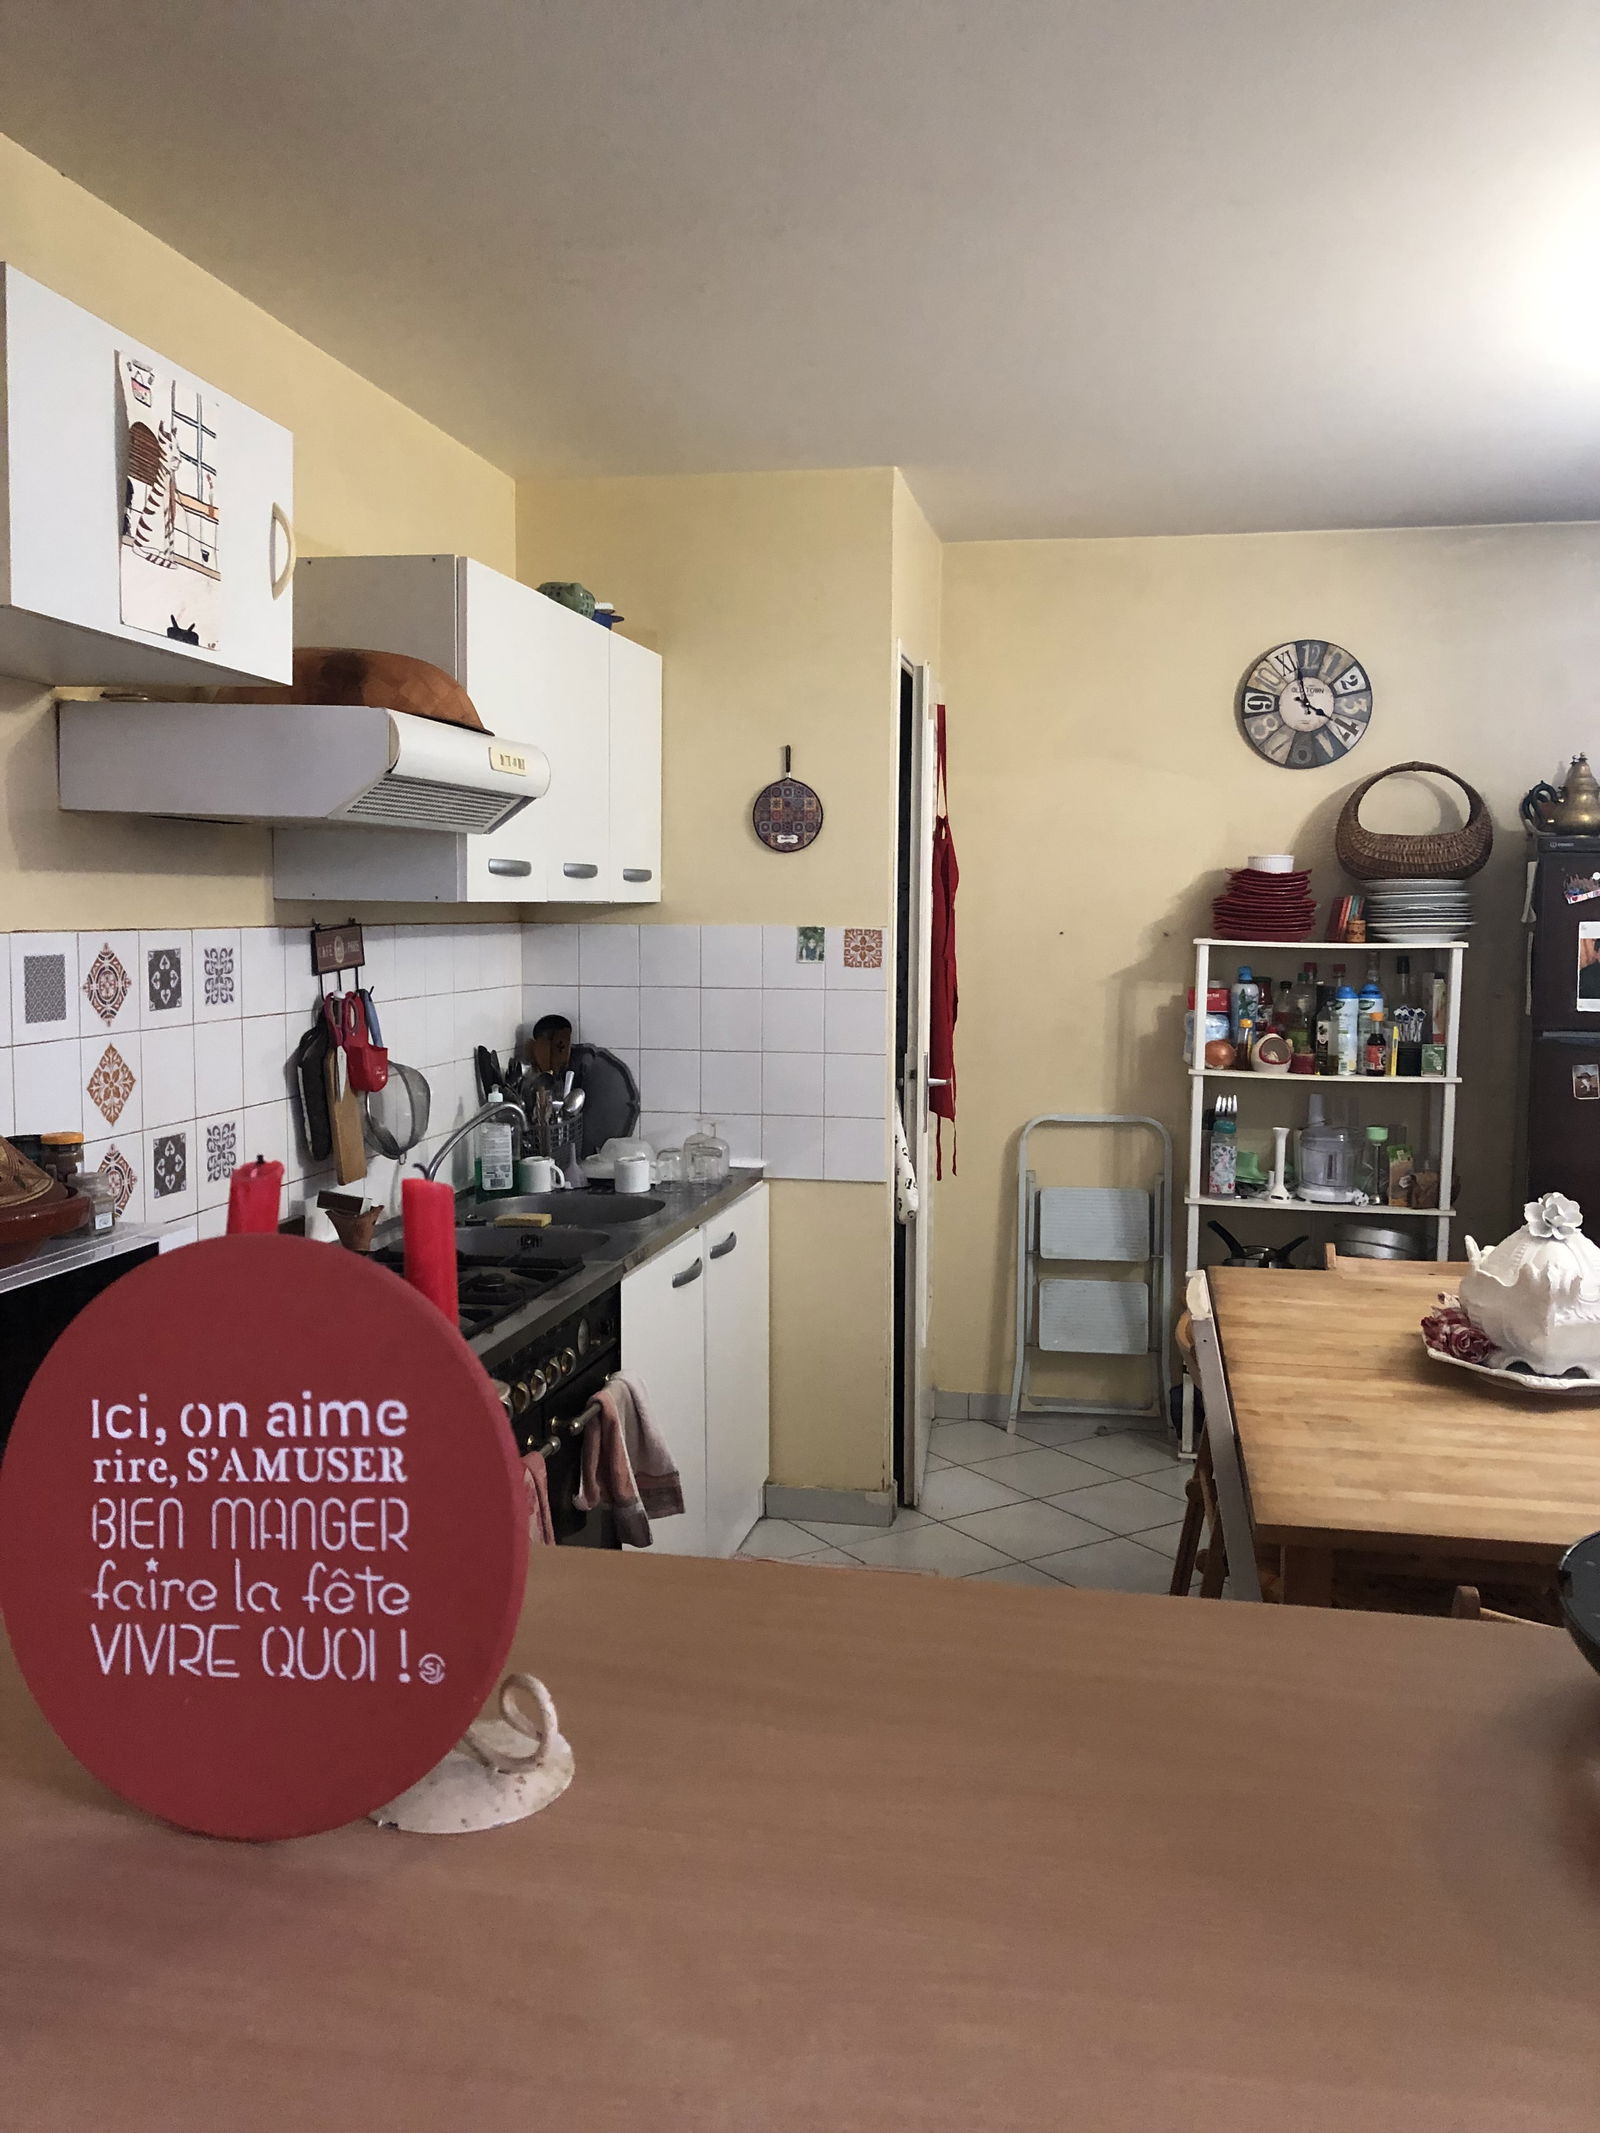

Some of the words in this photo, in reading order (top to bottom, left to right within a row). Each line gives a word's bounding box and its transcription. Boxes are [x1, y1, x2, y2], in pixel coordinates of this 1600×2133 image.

[1274, 649, 1297, 677] XI
[1301, 642, 1321, 669] 12
[1255, 667, 1282, 693] 10
[1340, 673, 1359, 692] 2
[1342, 697, 1368, 715] 3
[1249, 716, 1279, 740] 8
[1334, 716, 1360, 743] 4
[91, 1391, 167, 1447] Ici,
[180, 1401, 249, 1439] on
[266, 1390, 410, 1439] aime
[93, 1449, 179, 1489] rire,
[91, 1497, 185, 1550] BIEN
[211, 1497, 409, 1553] MANGER
[91, 1557, 219, 1613] faire
[233, 1557, 283, 1613] la
[301, 1560, 411, 1616] fête
[90, 1622, 242, 1679] VIVRE
[261, 1625, 376, 1682] QUOI
